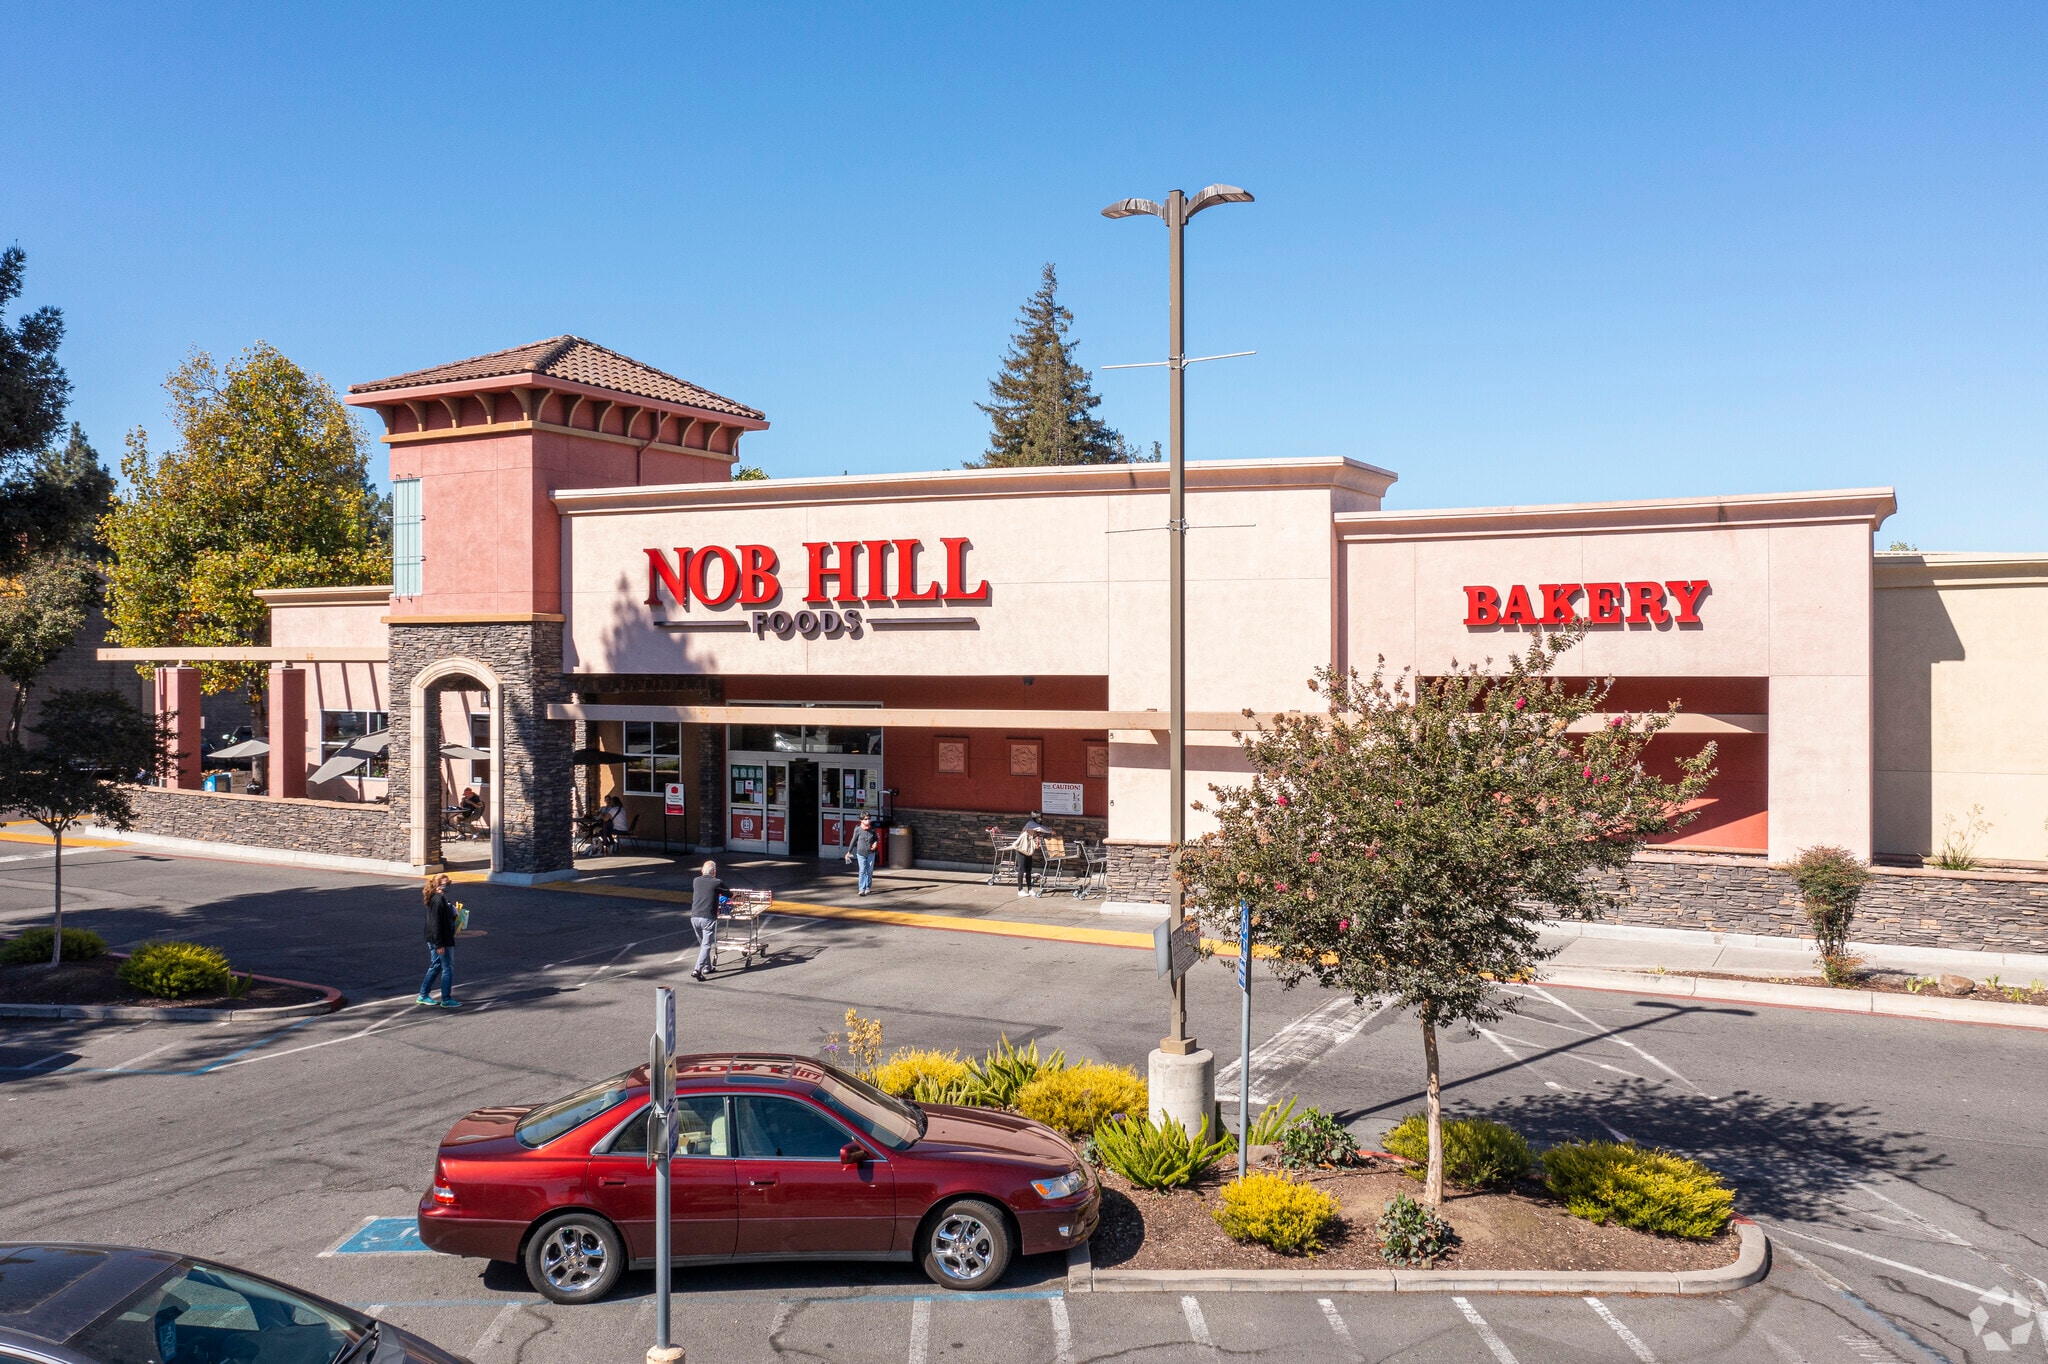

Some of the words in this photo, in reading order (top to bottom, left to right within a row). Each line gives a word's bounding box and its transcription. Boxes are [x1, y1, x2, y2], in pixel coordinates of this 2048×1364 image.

[643, 544, 780, 606] NOB
[802, 537, 988, 603] HILL
[752, 610, 862, 634] FOODS
[1463, 580, 1708, 625] BAKERY
